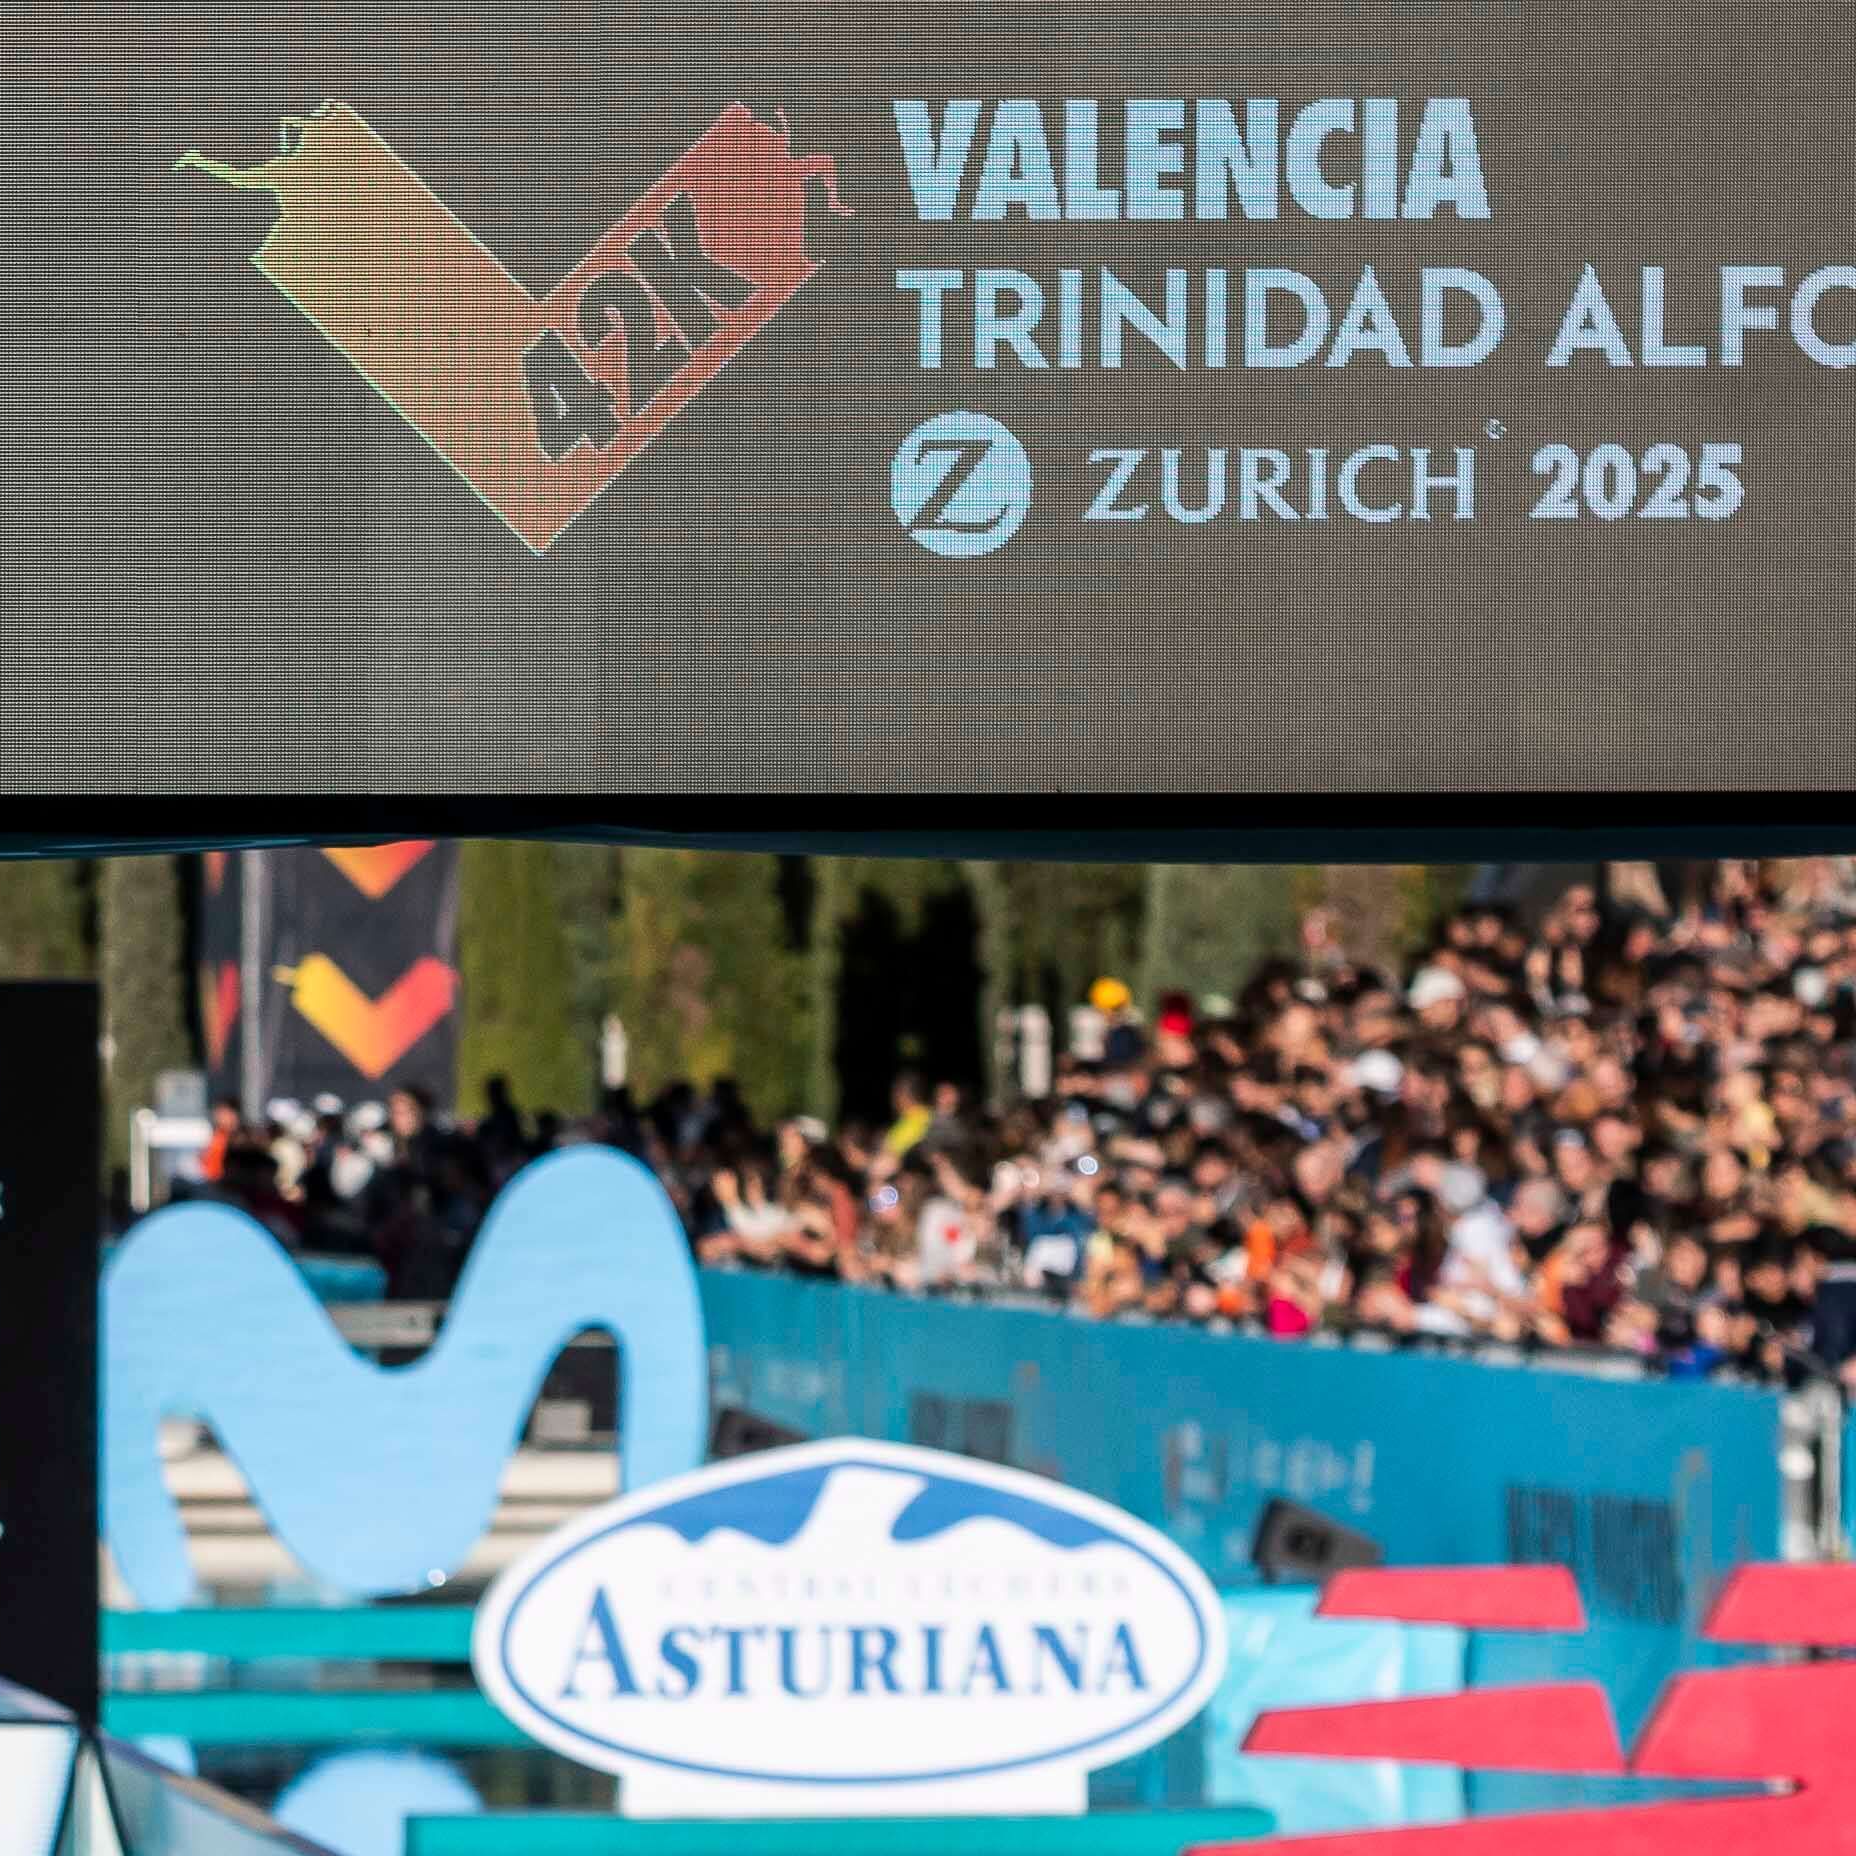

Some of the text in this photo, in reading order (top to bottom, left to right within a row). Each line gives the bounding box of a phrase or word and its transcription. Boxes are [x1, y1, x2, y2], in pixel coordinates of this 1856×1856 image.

[893, 98, 1492, 221] VALENCIA
[896, 263, 1506, 371] TRINIDAD
[1083, 444, 1476, 523] ZURICH
[1530, 443, 1746, 523] 2025
[558, 1585, 1151, 1700] ASTURIANA
